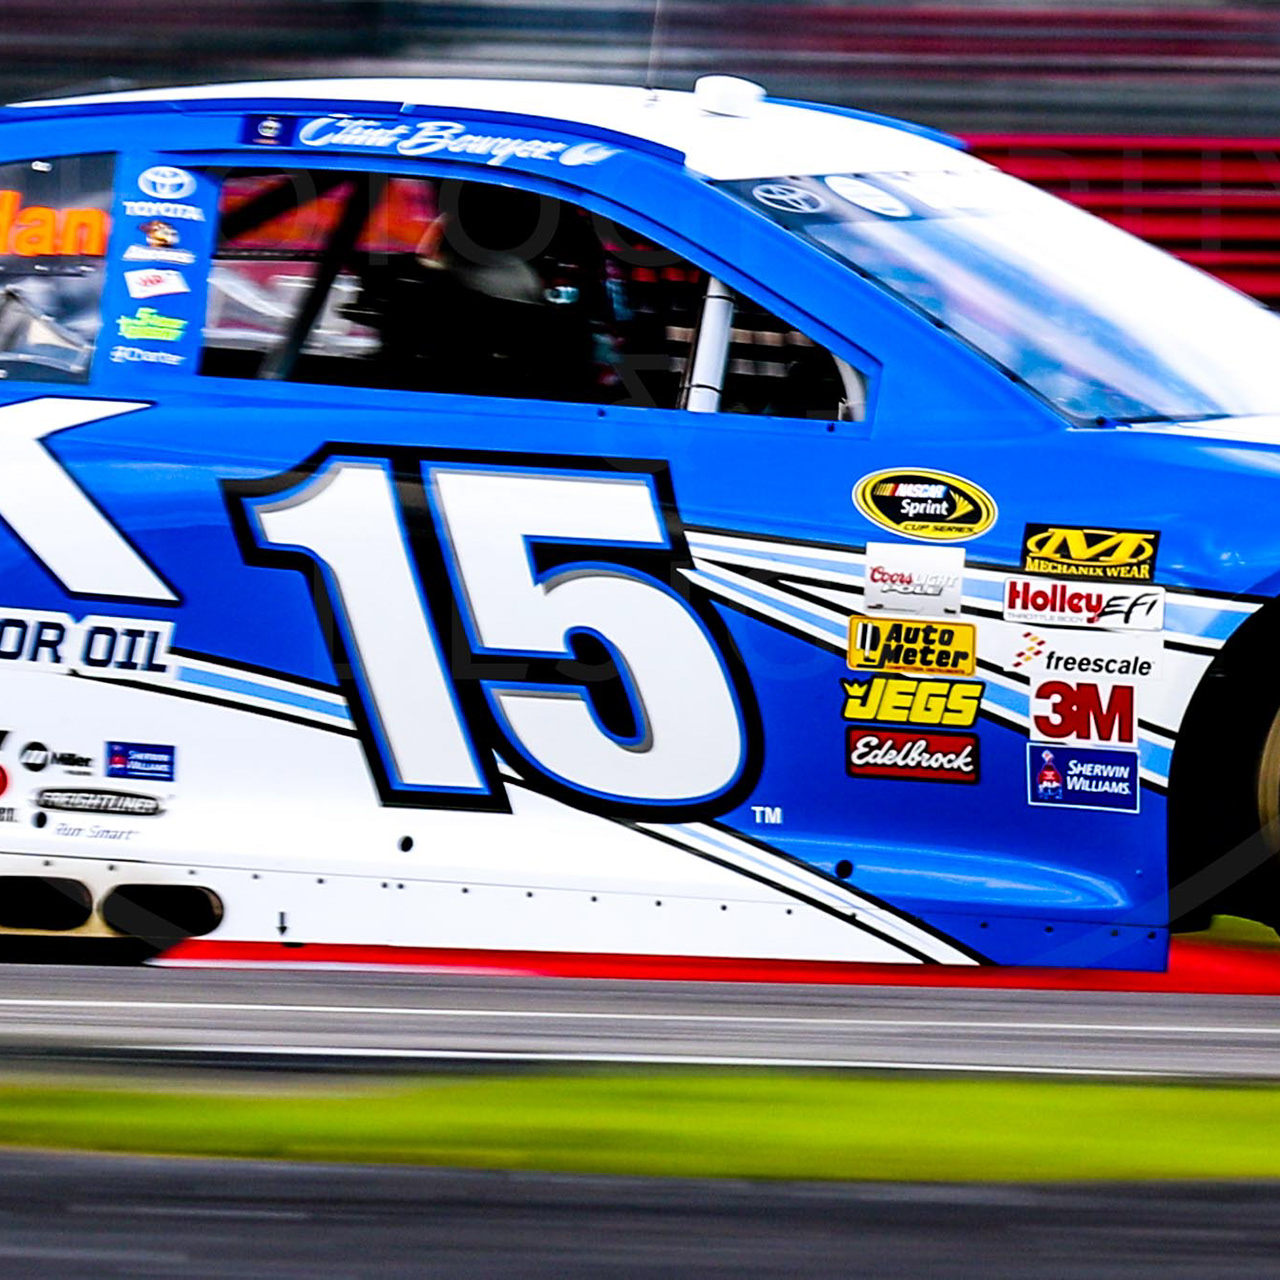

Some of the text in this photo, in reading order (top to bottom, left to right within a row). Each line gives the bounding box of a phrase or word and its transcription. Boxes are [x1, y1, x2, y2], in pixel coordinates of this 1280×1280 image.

[122, 200, 206, 222] TOYOTA
[895, 483, 948, 498] NASCAR
[900, 499, 949, 517] Sprint
[903, 523, 975, 533] CUP SERIES
[870, 566, 959, 588] Coors LIGHT
[1025, 557, 1150, 579] MECHANIX WEAR
[1008, 580, 1104, 624] Holley
[230, 446, 760, 820] 15
[886, 624, 955, 646] Auto
[79, 625, 168, 673] OIL
[875, 643, 969, 669] Meter
[1046, 651, 1152, 676] freescale
[844, 678, 983, 726] JEGS
[1034, 680, 1135, 744] 3M
[851, 736, 974, 772] Edelbrock
[1068, 760, 1130, 779] SHERWIN
[40, 791, 158, 813] FREIGHTLINER
[752, 806, 783, 825] TM
